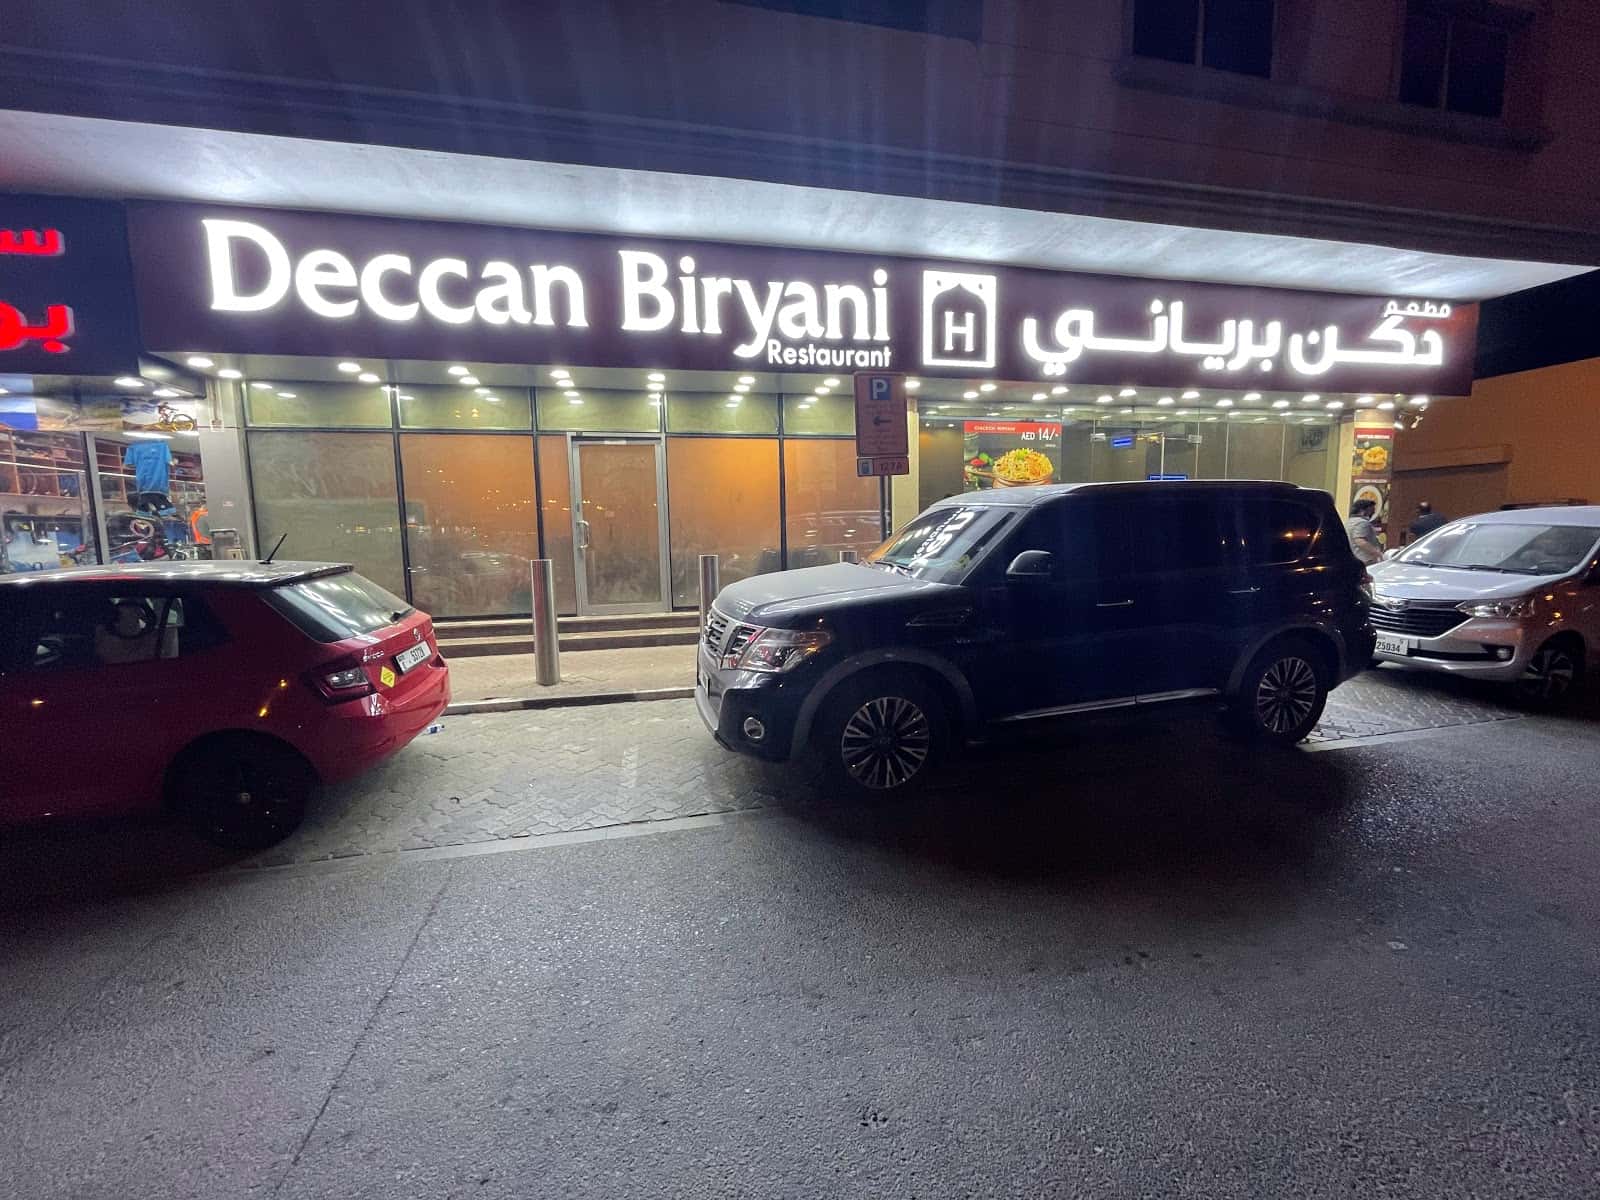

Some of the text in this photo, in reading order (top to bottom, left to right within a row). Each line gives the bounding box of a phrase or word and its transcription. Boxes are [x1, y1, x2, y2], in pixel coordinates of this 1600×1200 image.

[201, 218, 891, 359] Deccan Biryani
[1383, 300, 1451, 319] مطعم
[944, 311, 975, 352] H
[1022, 299, 1444, 376] دكن برياني
[767, 339, 892, 367] Restaurant
[872, 379, 889, 400] P
[1020, 431, 1036, 441] AED
